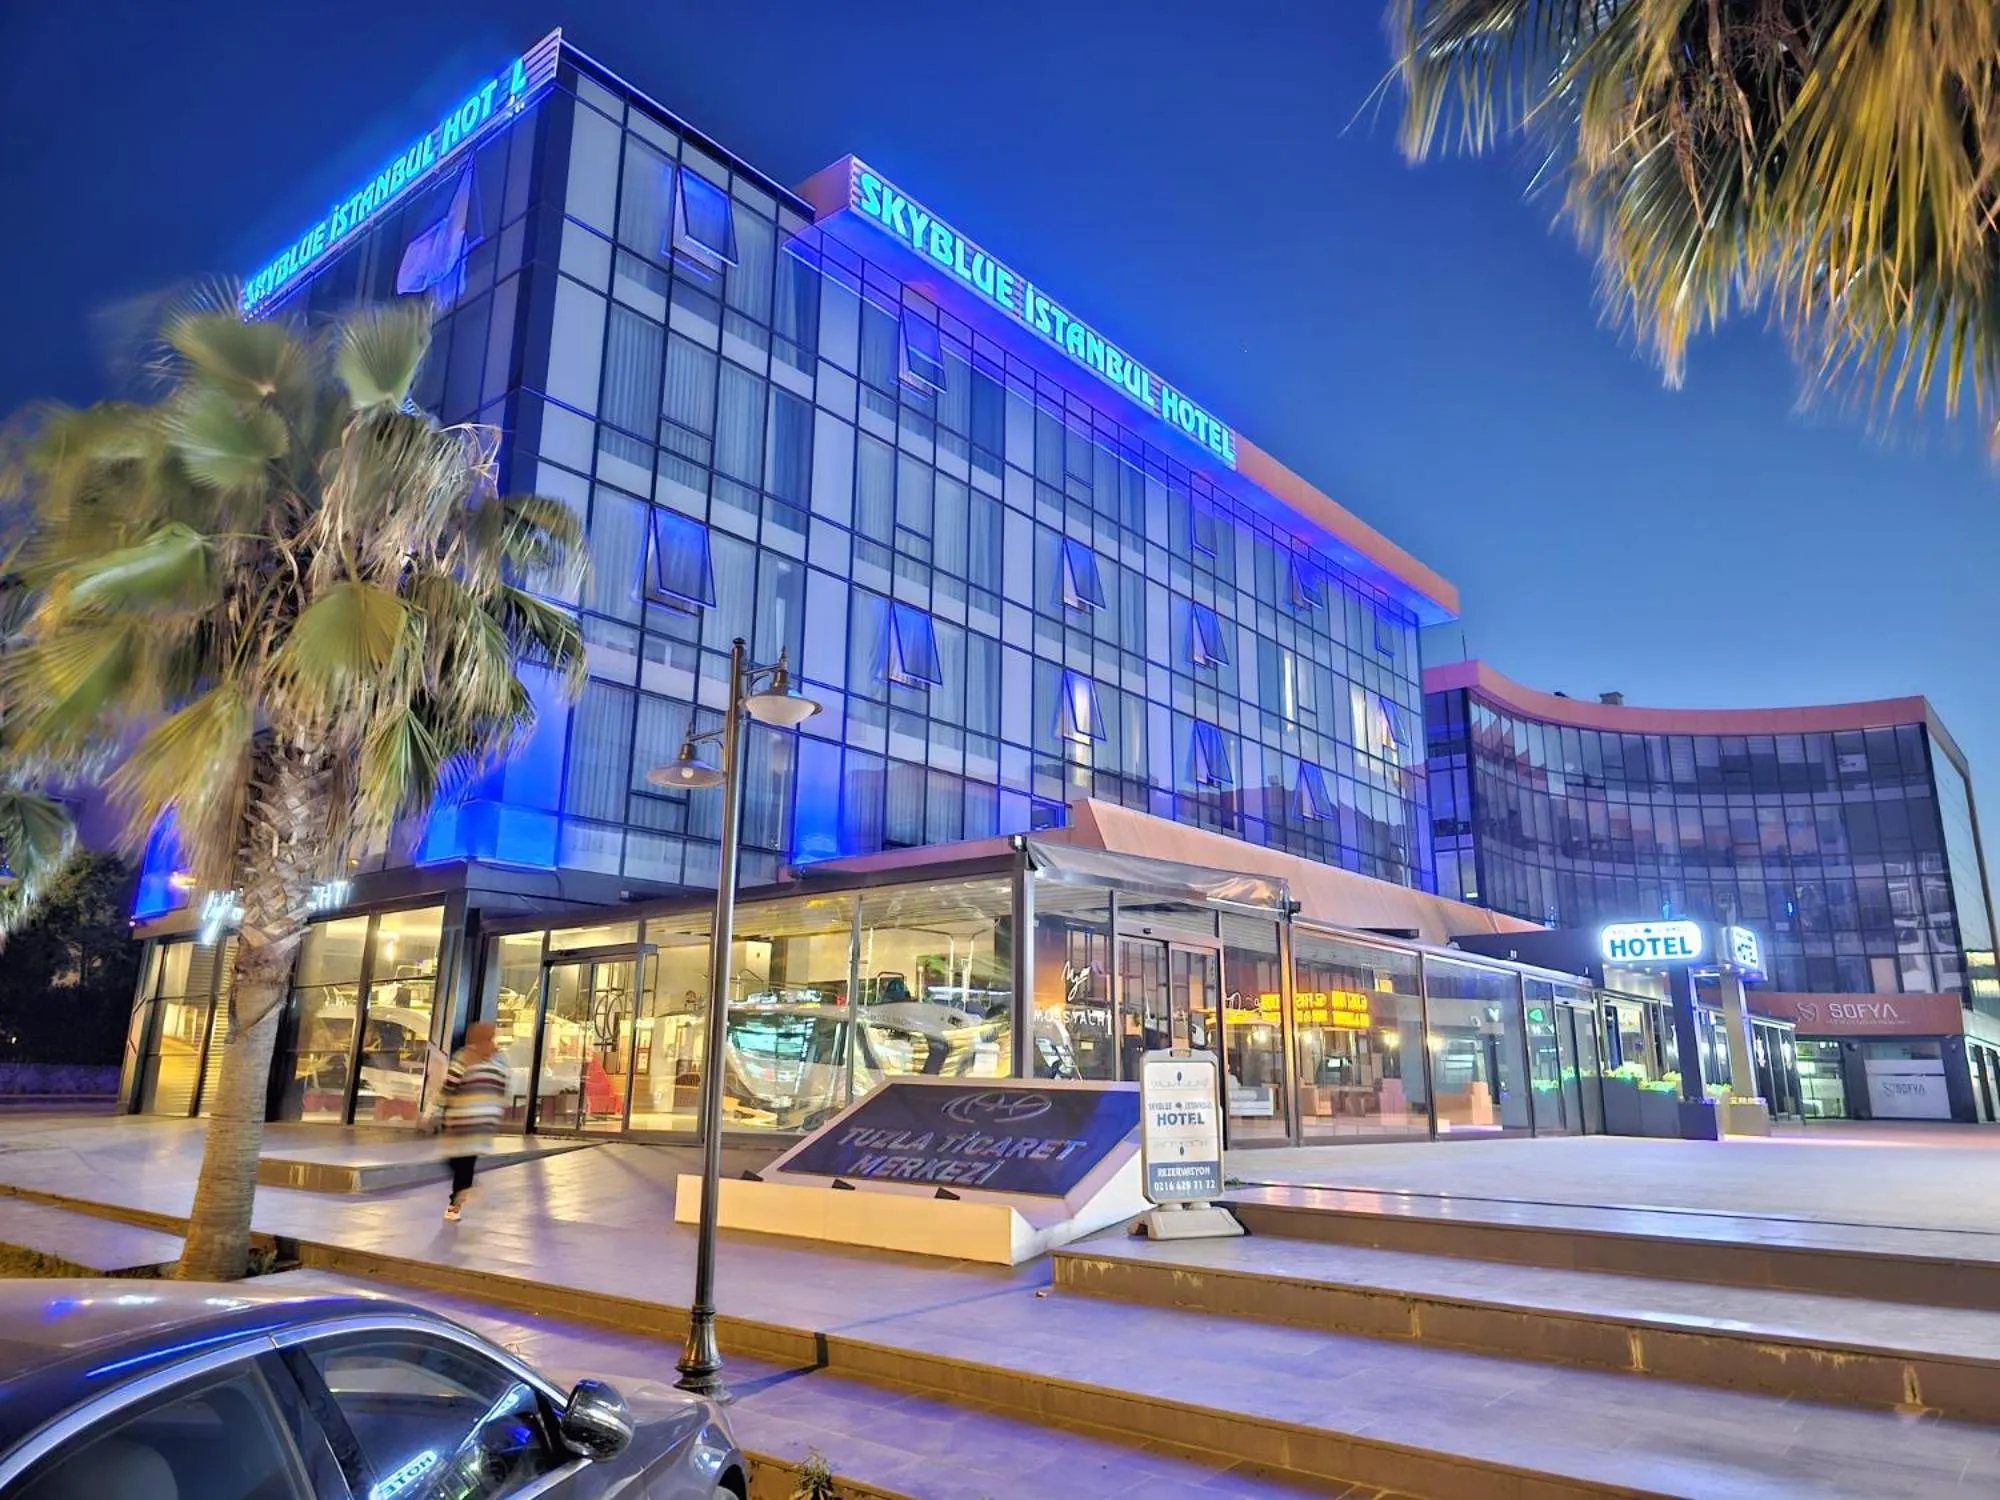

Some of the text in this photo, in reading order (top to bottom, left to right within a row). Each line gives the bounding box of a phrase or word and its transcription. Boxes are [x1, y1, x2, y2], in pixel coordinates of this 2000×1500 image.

[330, 134, 435, 242] İSTANBUL
[861, 173, 1236, 462] SKYBLUE İSTANBUL HOTEL
[1610, 936, 1693, 957] HOTEL
[1829, 1003, 1899, 1019] SOFYA
[1156, 1113, 1206, 1127] HOTEL
[837, 1127, 1088, 1161] TUZLA TİCARET
[848, 1153, 1006, 1185] MERKEZİ
